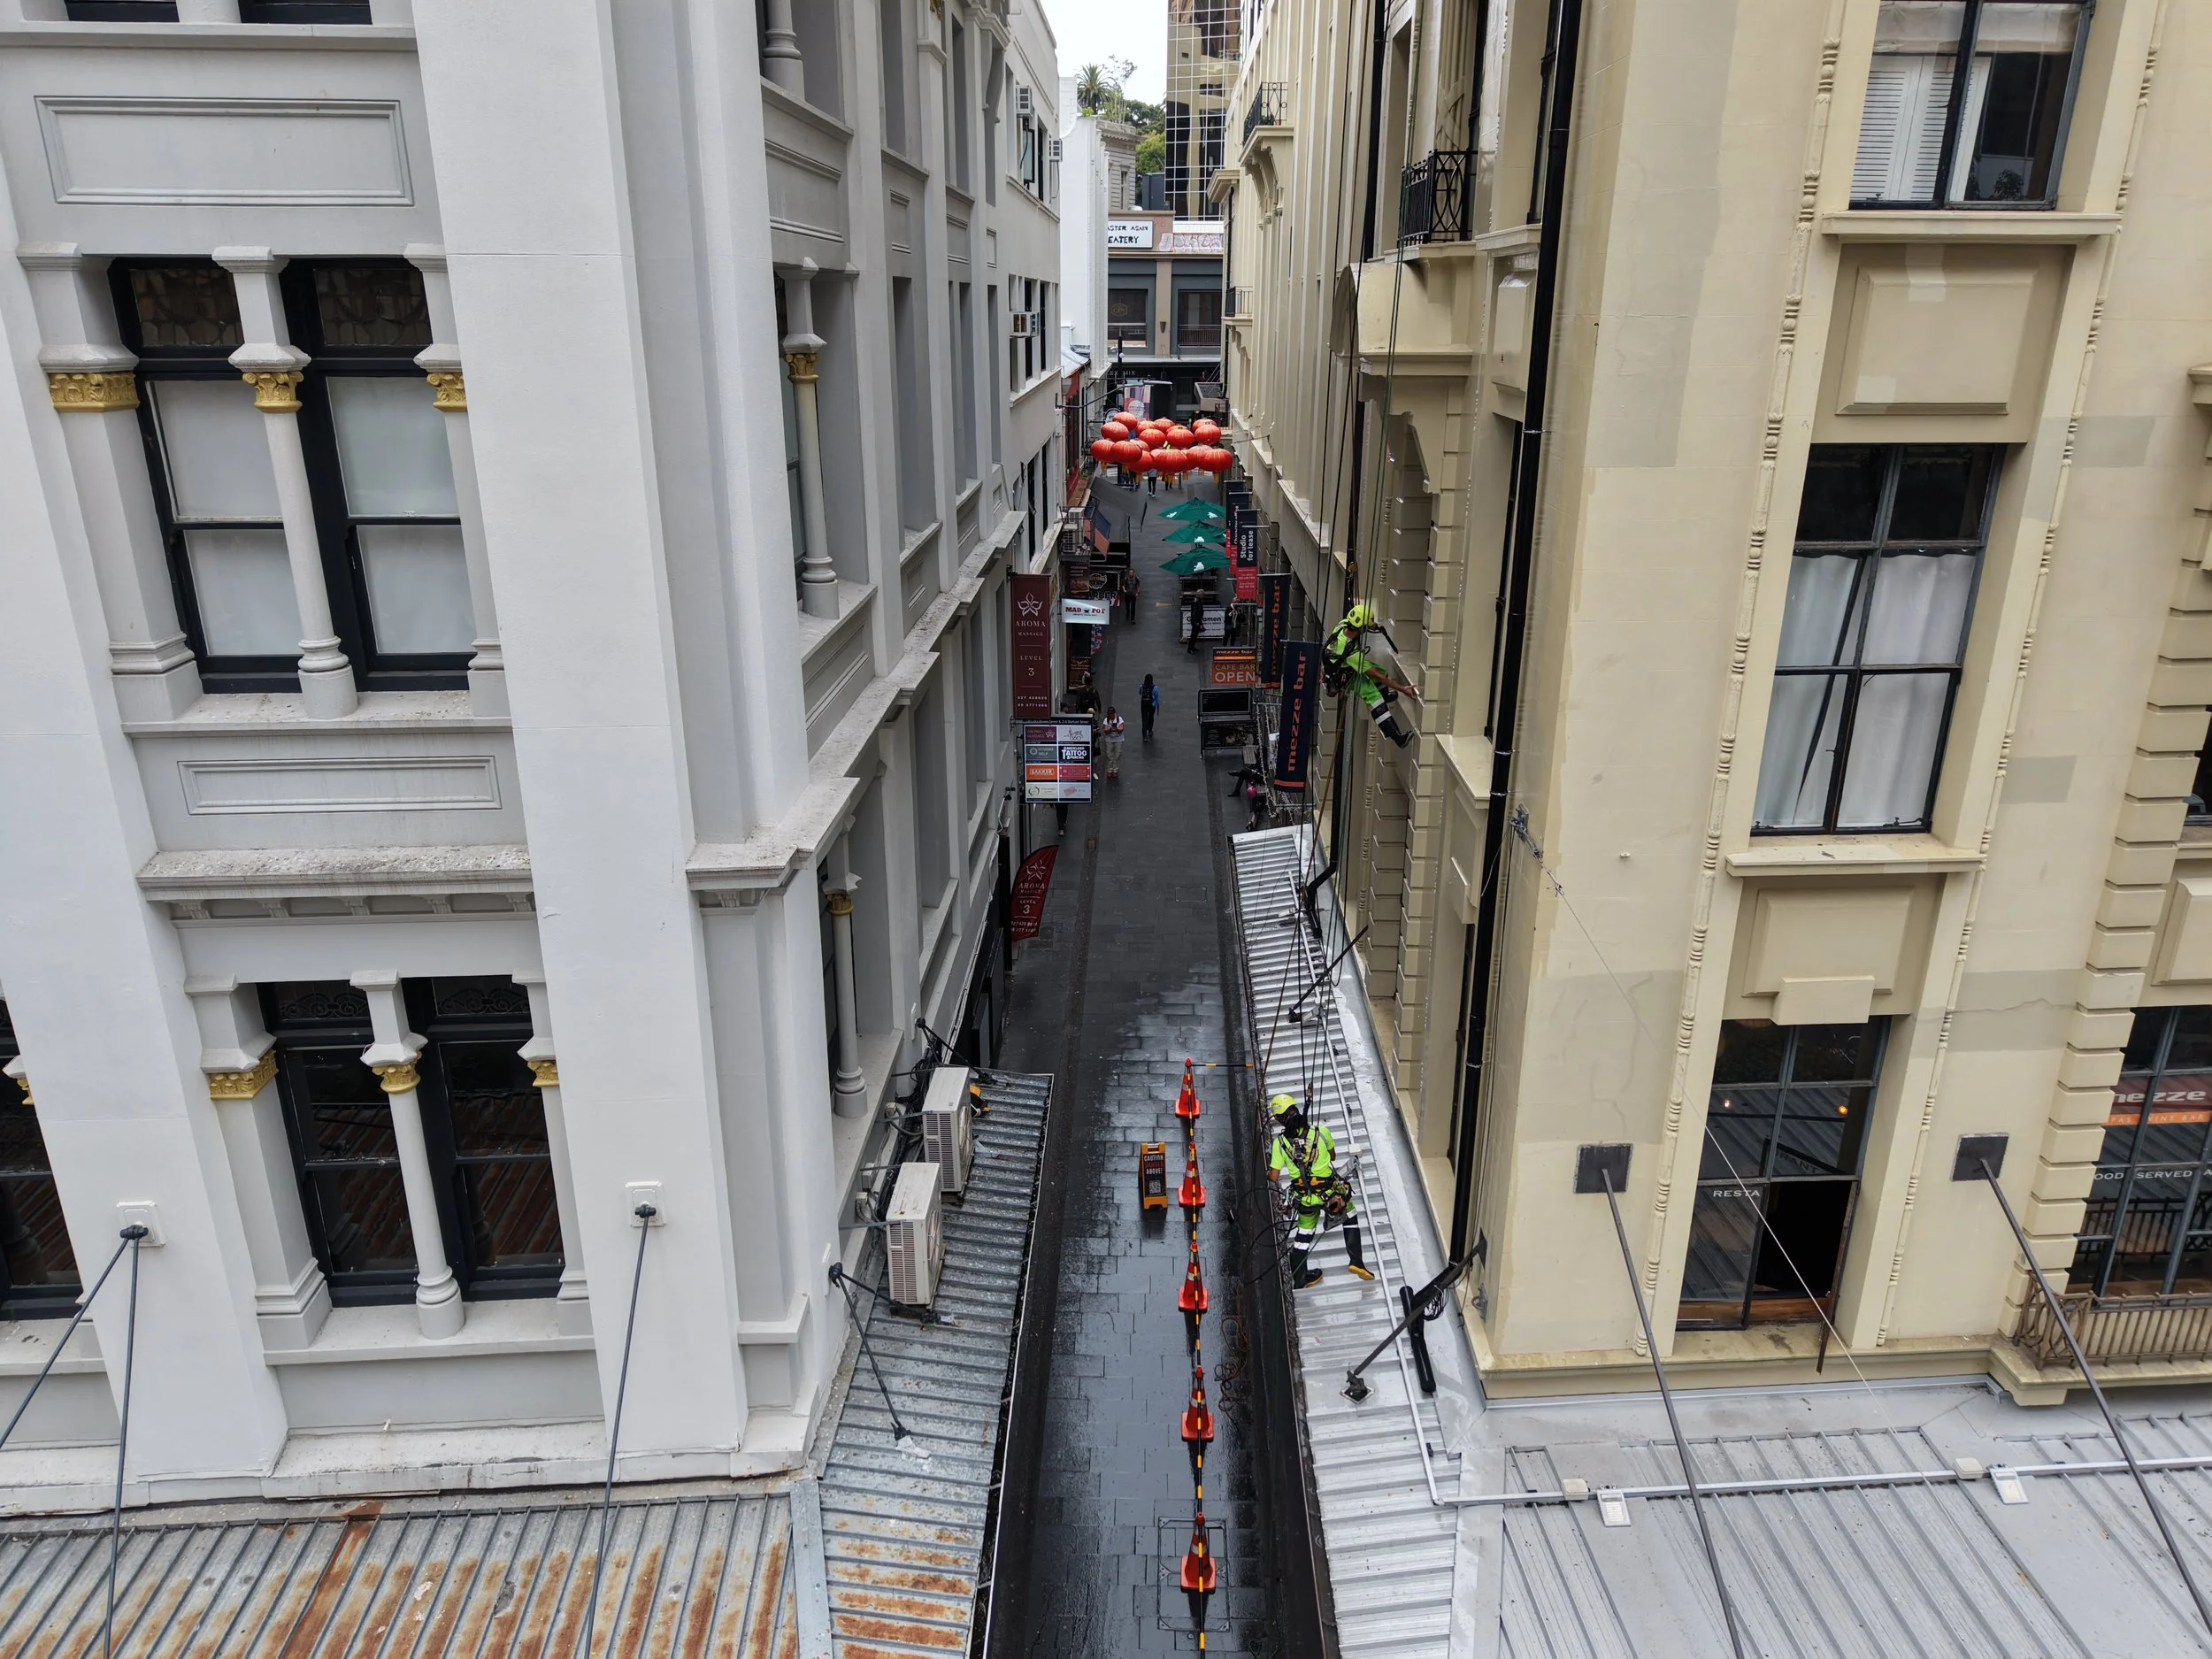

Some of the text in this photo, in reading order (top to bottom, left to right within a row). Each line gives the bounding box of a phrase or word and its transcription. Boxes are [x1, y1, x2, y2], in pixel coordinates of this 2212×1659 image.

[1271, 580, 1280, 614] bar
[1028, 667, 1035, 677] 3
[1215, 671, 1256, 682] OPEN
[1287, 650, 1307, 772] mezze bar
[1061, 749, 1087, 759] TATTOO
[1023, 904, 1031, 914] 3
[2136, 1170, 2193, 1179] SERVED
